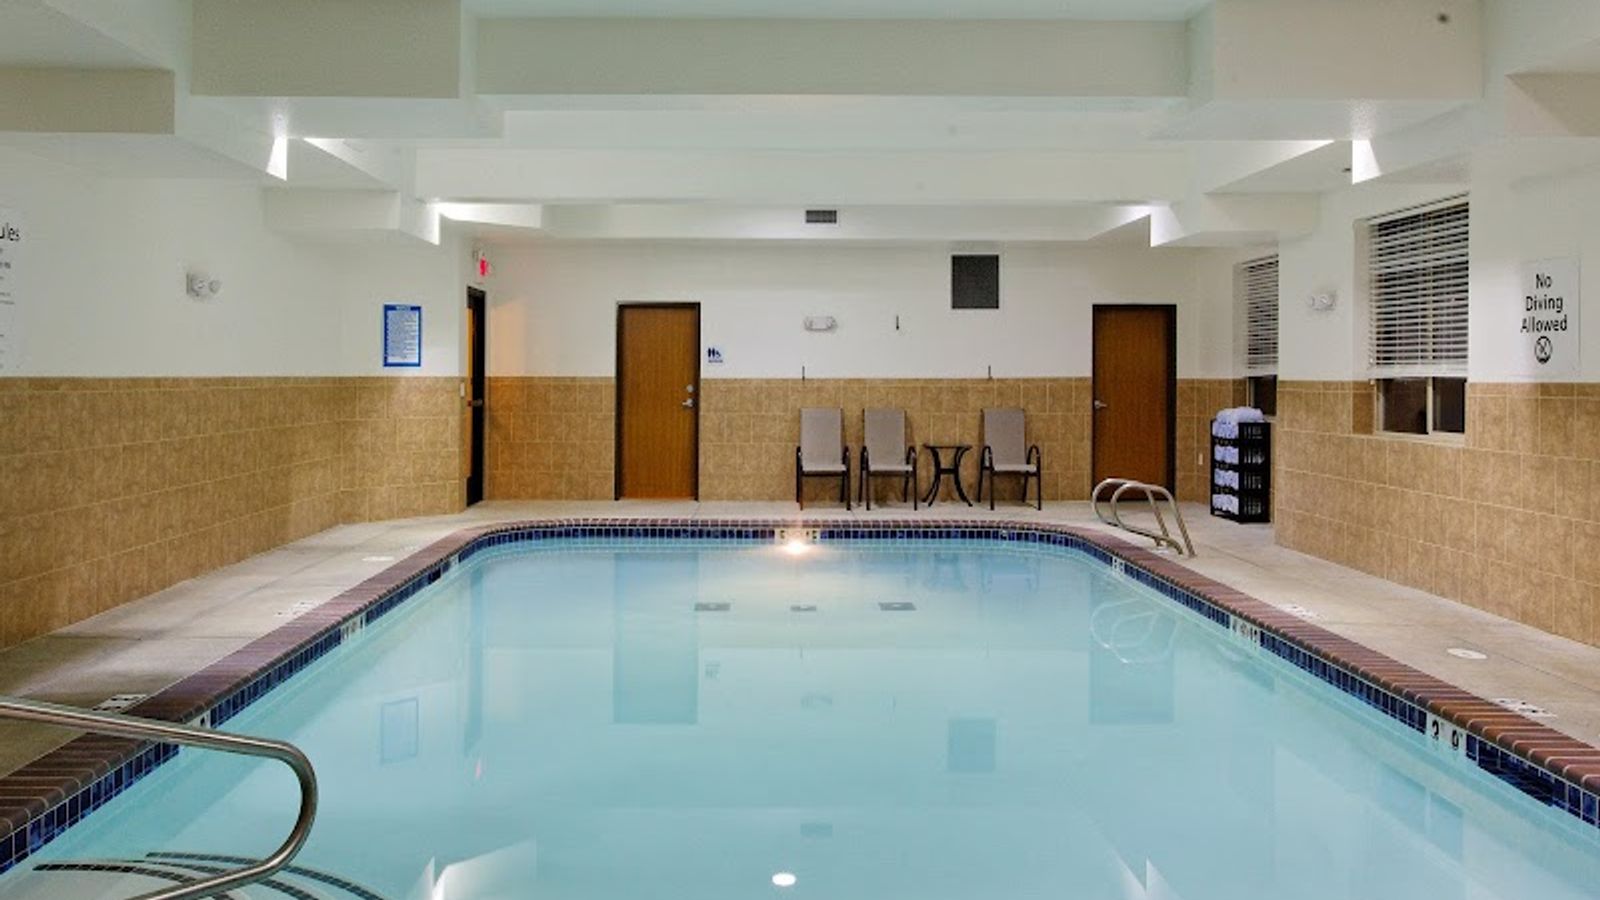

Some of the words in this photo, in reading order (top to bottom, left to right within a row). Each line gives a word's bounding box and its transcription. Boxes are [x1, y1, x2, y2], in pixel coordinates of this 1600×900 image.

[1536, 273, 1554, 289] No
[1525, 294, 1564, 313] Diving
[1520, 314, 1568, 334] Allowed
